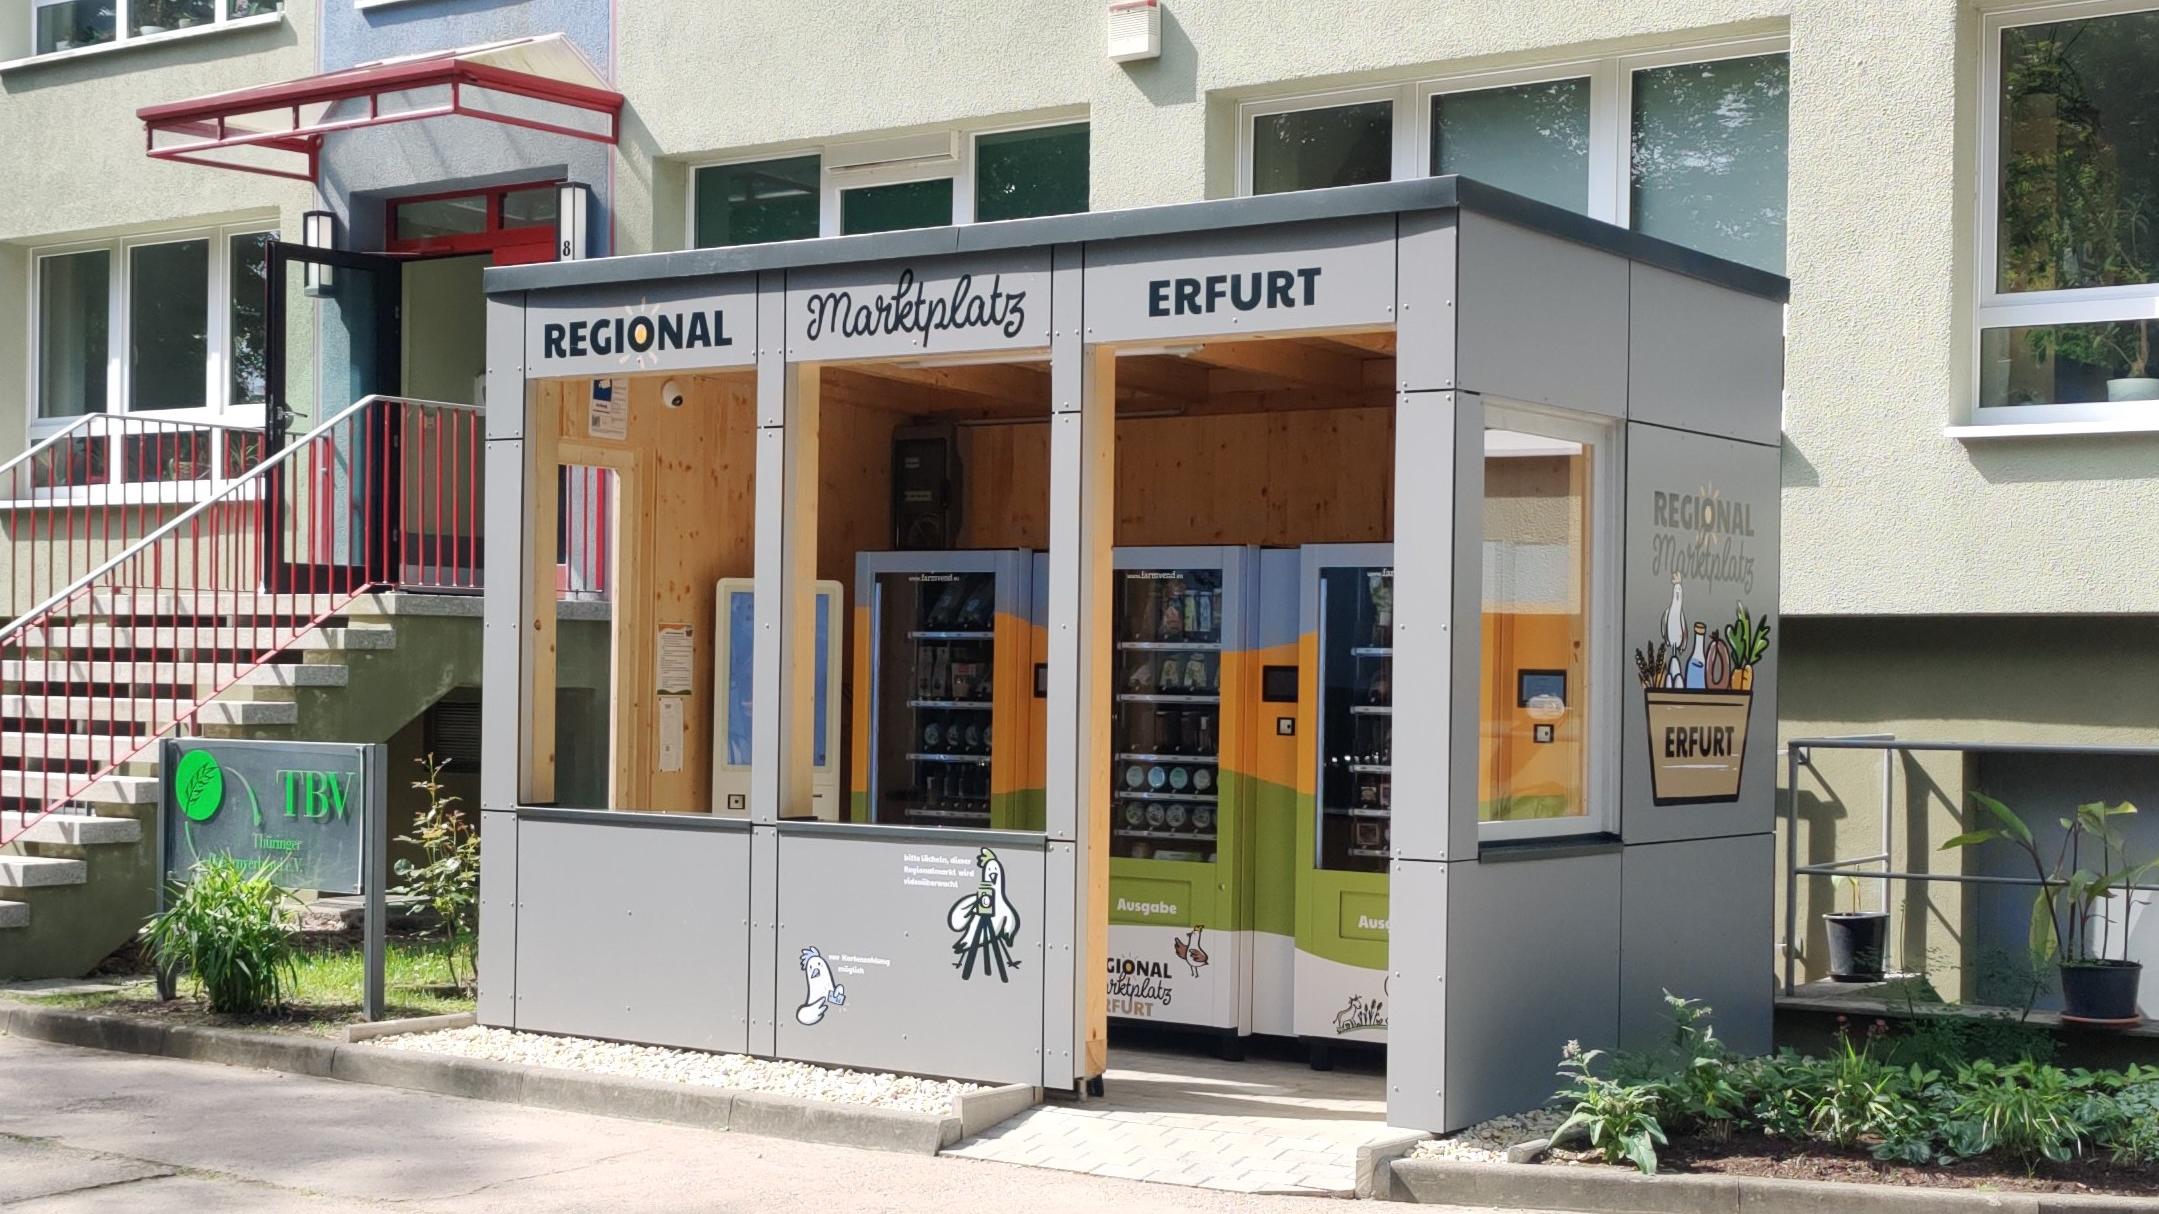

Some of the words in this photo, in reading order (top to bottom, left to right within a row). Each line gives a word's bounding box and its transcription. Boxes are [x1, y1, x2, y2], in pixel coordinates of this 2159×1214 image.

[563, 240, 571, 257] 8
[806, 267, 1028, 347] Marktplatz
[1148, 266, 1323, 318] ERFURT
[545, 308, 733, 359] REGIONAL
[1653, 490, 1755, 537] REGIONAL
[1652, 530, 1754, 595] Marktplatz
[1664, 725, 1735, 758] ERFURT
[276, 769, 358, 819] TBV
[251, 832, 304, 853] Thüringer
[903, 865, 957, 877] Regionalmarkt
[958, 868, 975, 877] wird
[1117, 897, 1178, 917] Ausgabe
